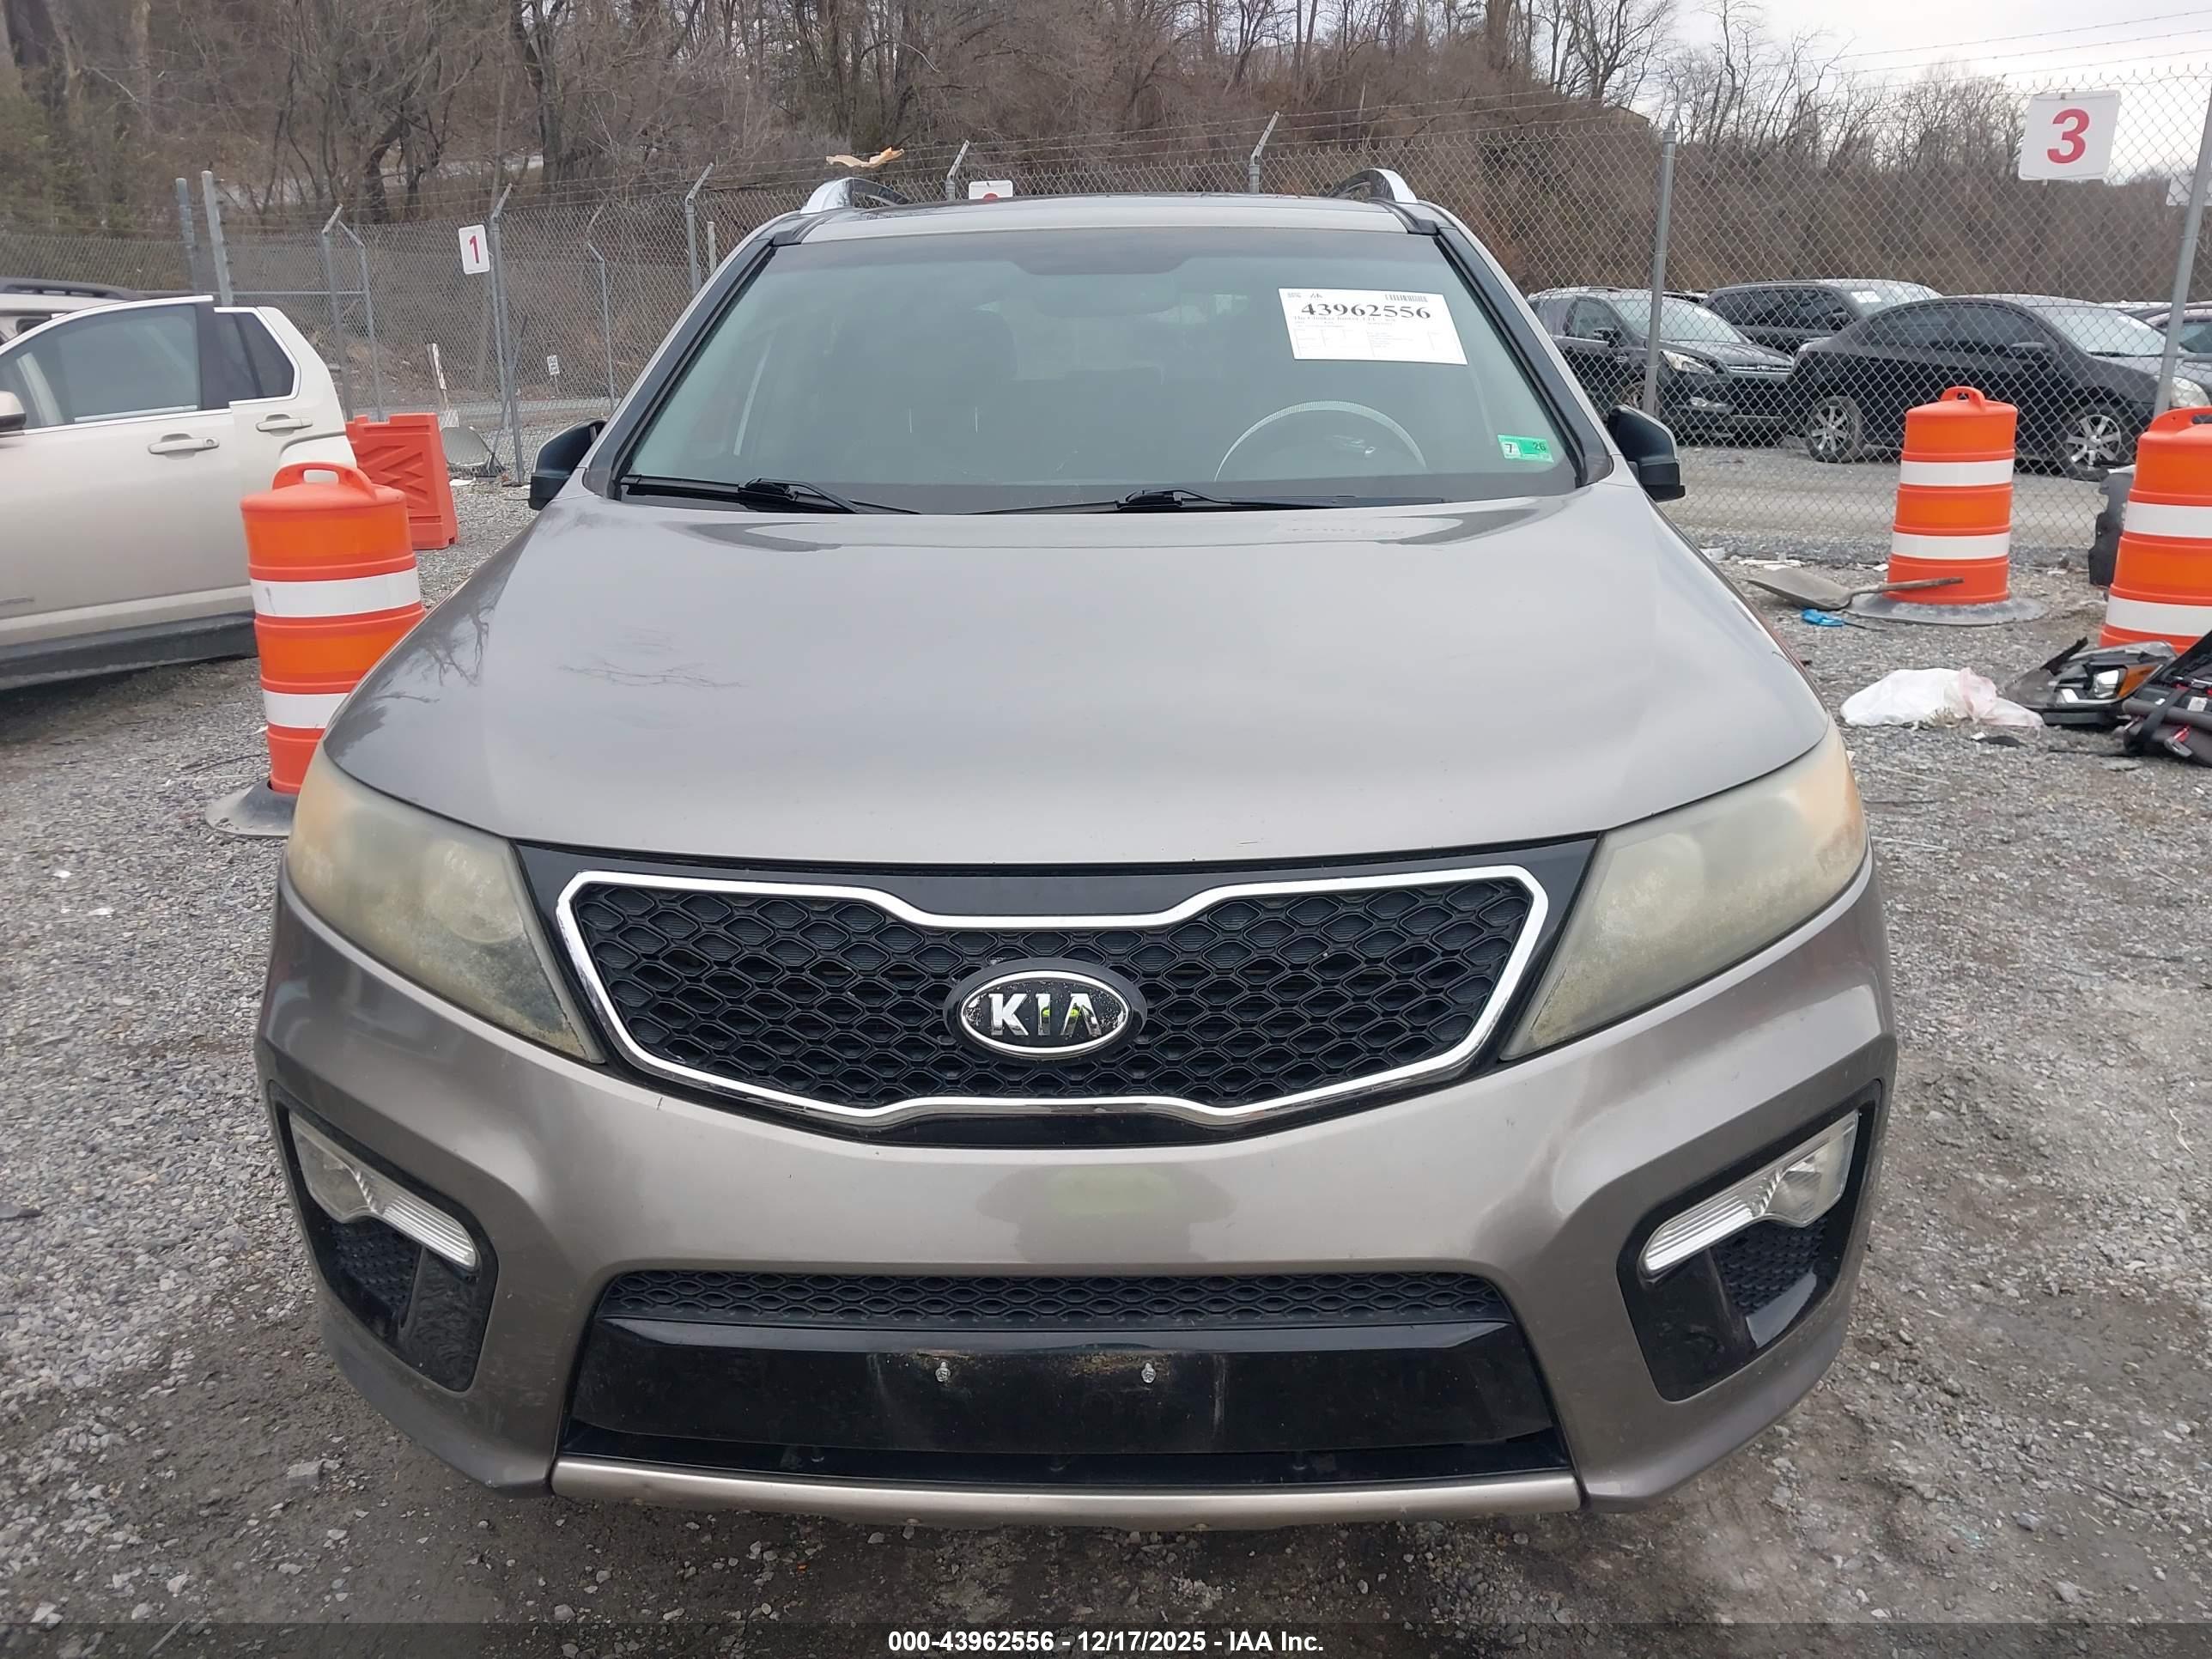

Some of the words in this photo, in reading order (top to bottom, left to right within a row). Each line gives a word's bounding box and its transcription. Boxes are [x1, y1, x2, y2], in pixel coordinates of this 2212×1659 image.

[2046, 108, 2090, 164] 3
[469, 234, 480, 264] 1
[1301, 302, 1431, 319] 43962556
[1504, 443, 1512, 453] 7
[1532, 441, 1547, 452] 26
[988, 993, 1103, 1036] KIA
